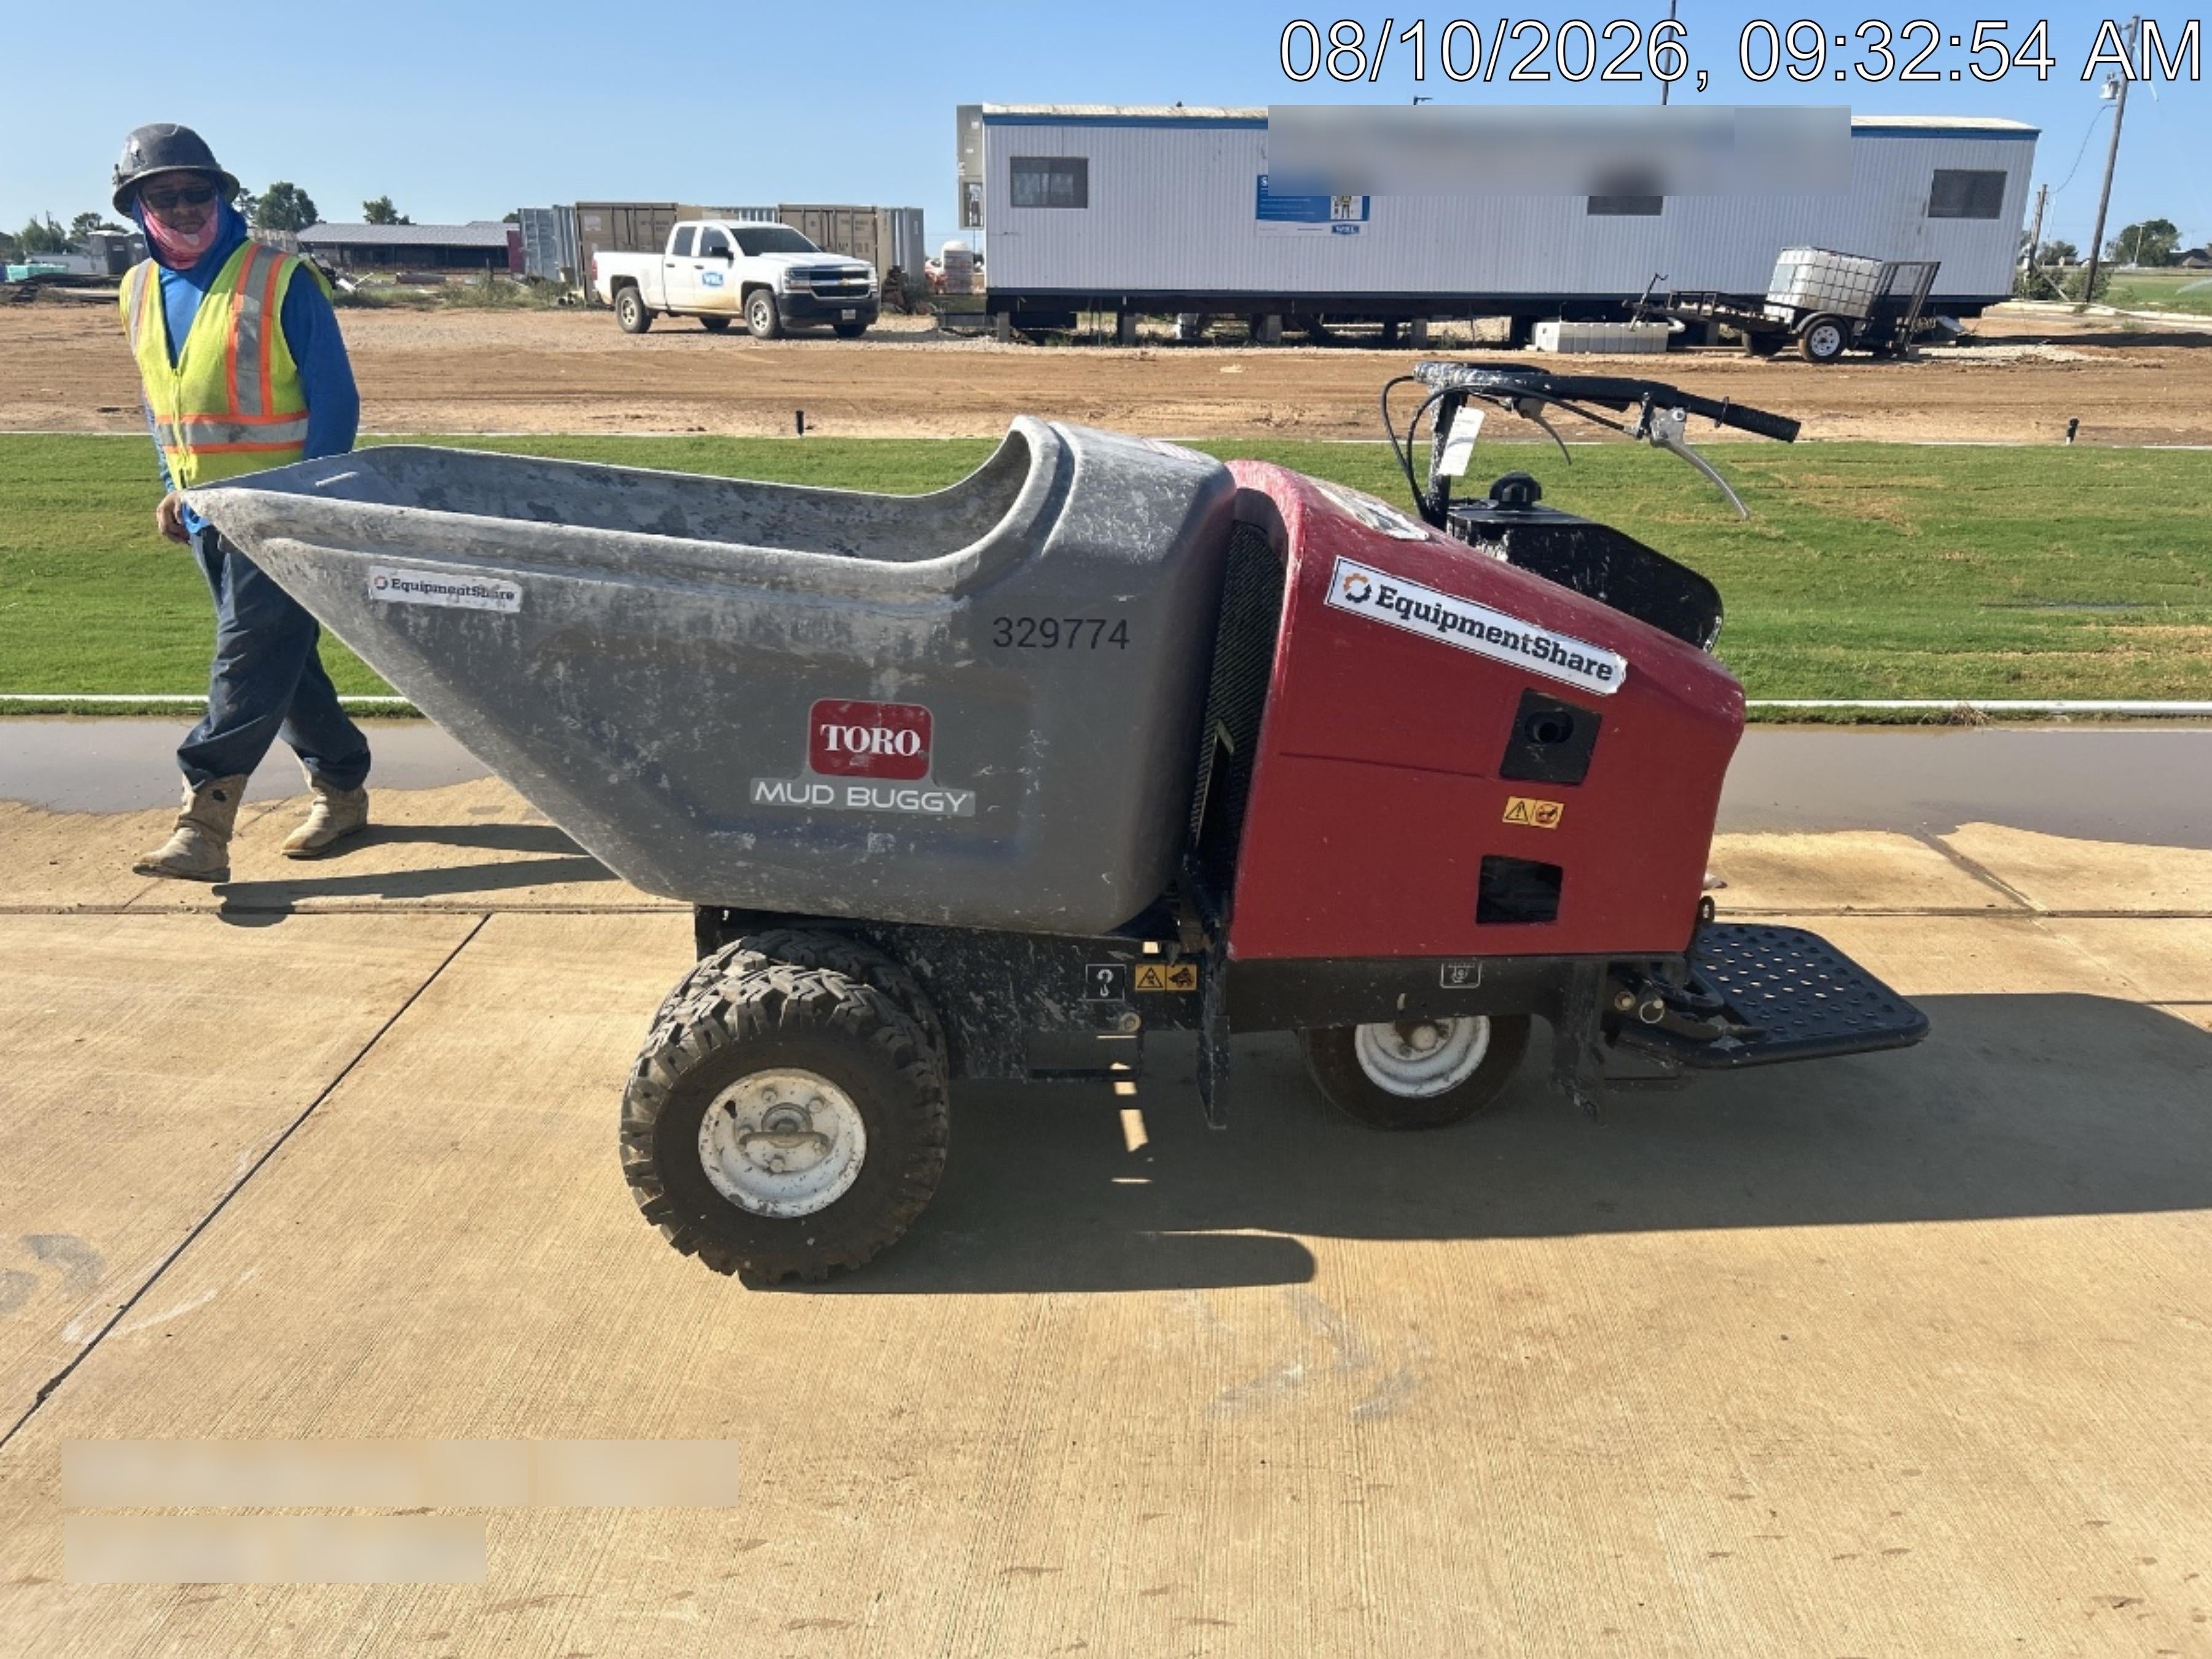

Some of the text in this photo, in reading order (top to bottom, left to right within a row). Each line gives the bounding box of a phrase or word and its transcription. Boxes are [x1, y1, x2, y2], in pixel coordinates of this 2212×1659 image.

[993, 617, 1130, 650] 329774
[1375, 584, 1613, 681] EquipmentShare
[820, 724, 921, 756] TORO
[755, 781, 968, 812] MUD BUGGY
